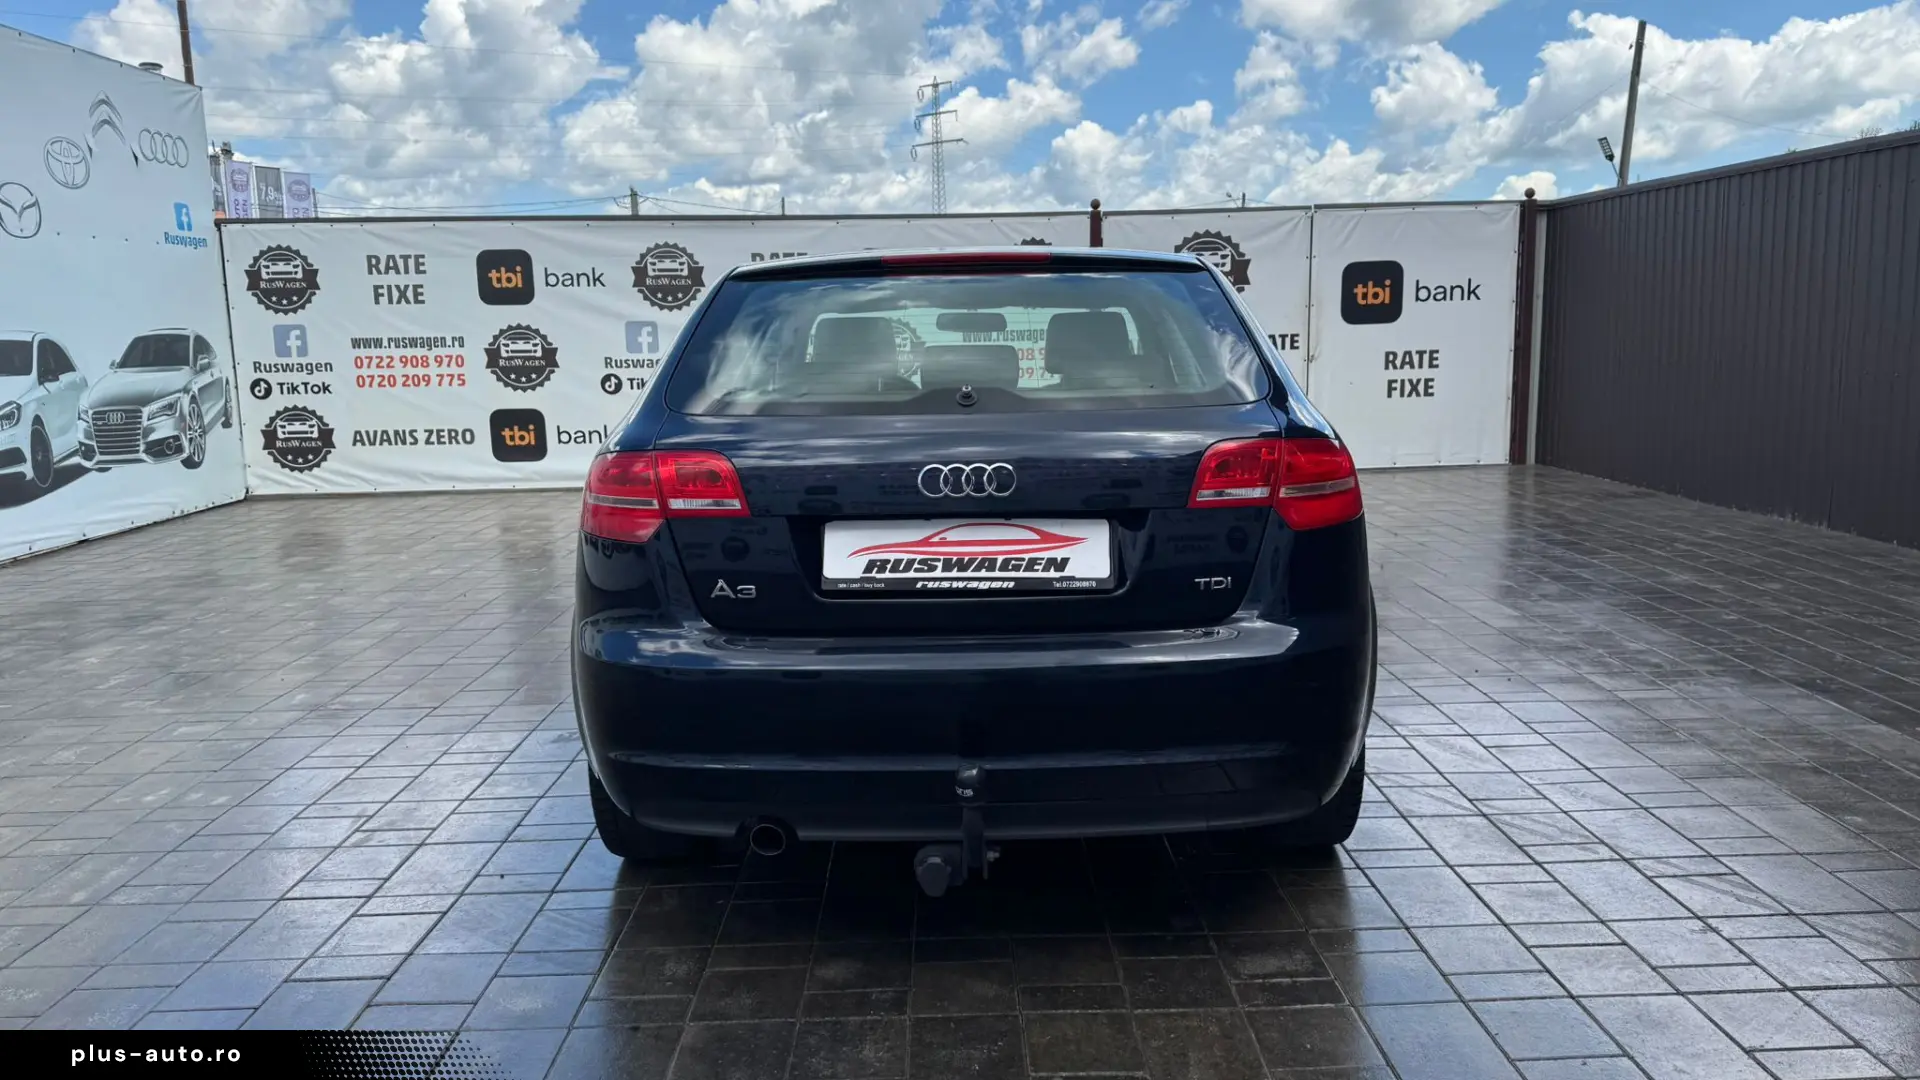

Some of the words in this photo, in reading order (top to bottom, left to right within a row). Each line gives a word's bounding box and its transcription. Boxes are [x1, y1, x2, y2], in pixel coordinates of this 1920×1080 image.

[164, 232, 208, 250] Ruswagen
[366, 254, 427, 276] RATE
[487, 266, 523, 289] tbi
[544, 267, 606, 287] bank
[372, 284, 426, 305] FIXE
[1353, 279, 1391, 305] tbi
[1415, 278, 1481, 303] bank
[350, 335, 465, 351] www.ruswagen.ro
[253, 361, 333, 376] Ruswagen
[354, 355, 395, 369] 0722
[399, 355, 430, 369] 908
[434, 354, 465, 368] 970
[1384, 349, 1440, 371] RATE
[276, 381, 333, 395] TikTok
[356, 374, 396, 388] 0720
[401, 374, 431, 388] 209
[435, 373, 466, 387] 775
[1387, 378, 1435, 399] FIXE
[352, 429, 419, 447] AVANS
[424, 428, 475, 446] ZERO
[501, 425, 536, 447] tbi
[862, 557, 1071, 575] RUSWAGEN
[711, 578, 757, 599] A3
[915, 580, 1016, 589] ruswagen
[1194, 577, 1232, 590] TDI
